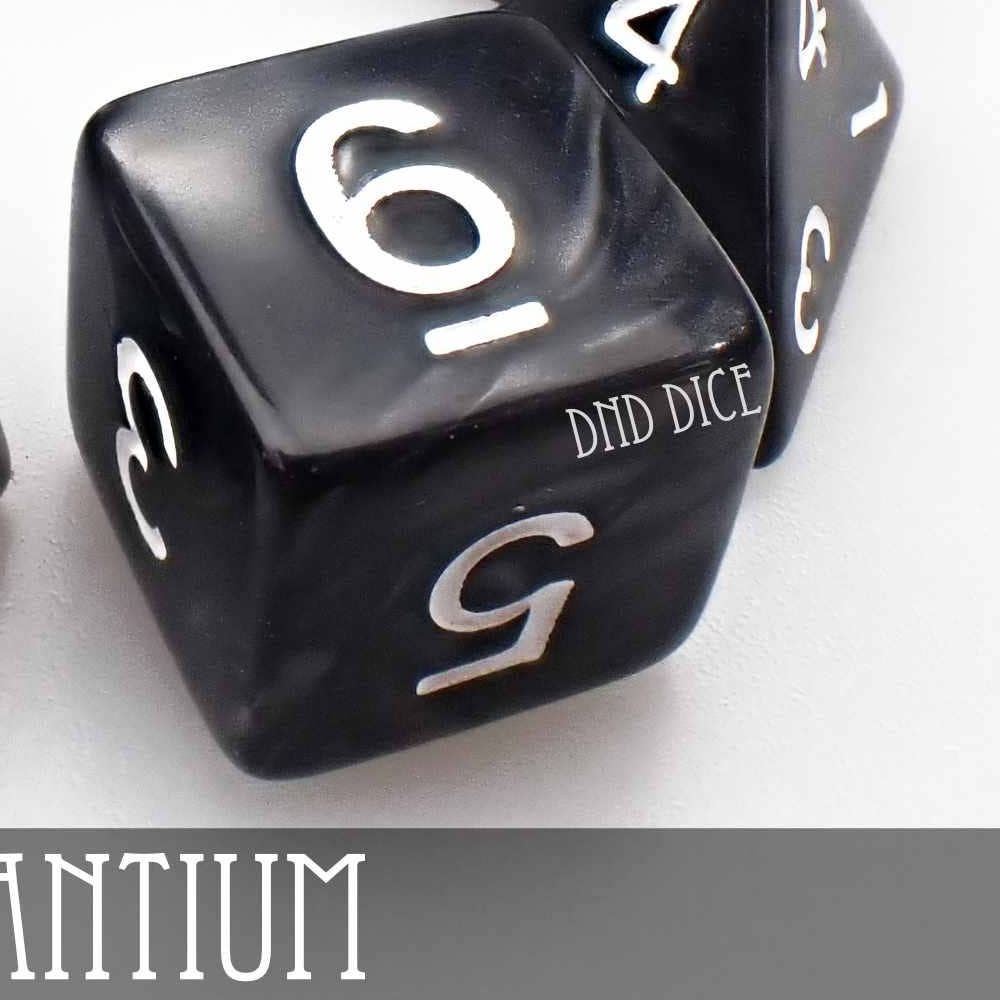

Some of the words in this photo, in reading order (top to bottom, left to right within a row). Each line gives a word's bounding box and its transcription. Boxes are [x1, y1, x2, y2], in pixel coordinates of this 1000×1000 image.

[295, 97, 551, 356] 6
[795, 205, 830, 355] 3
[116, 337, 178, 561] 3
[416, 511, 595, 697] 5
